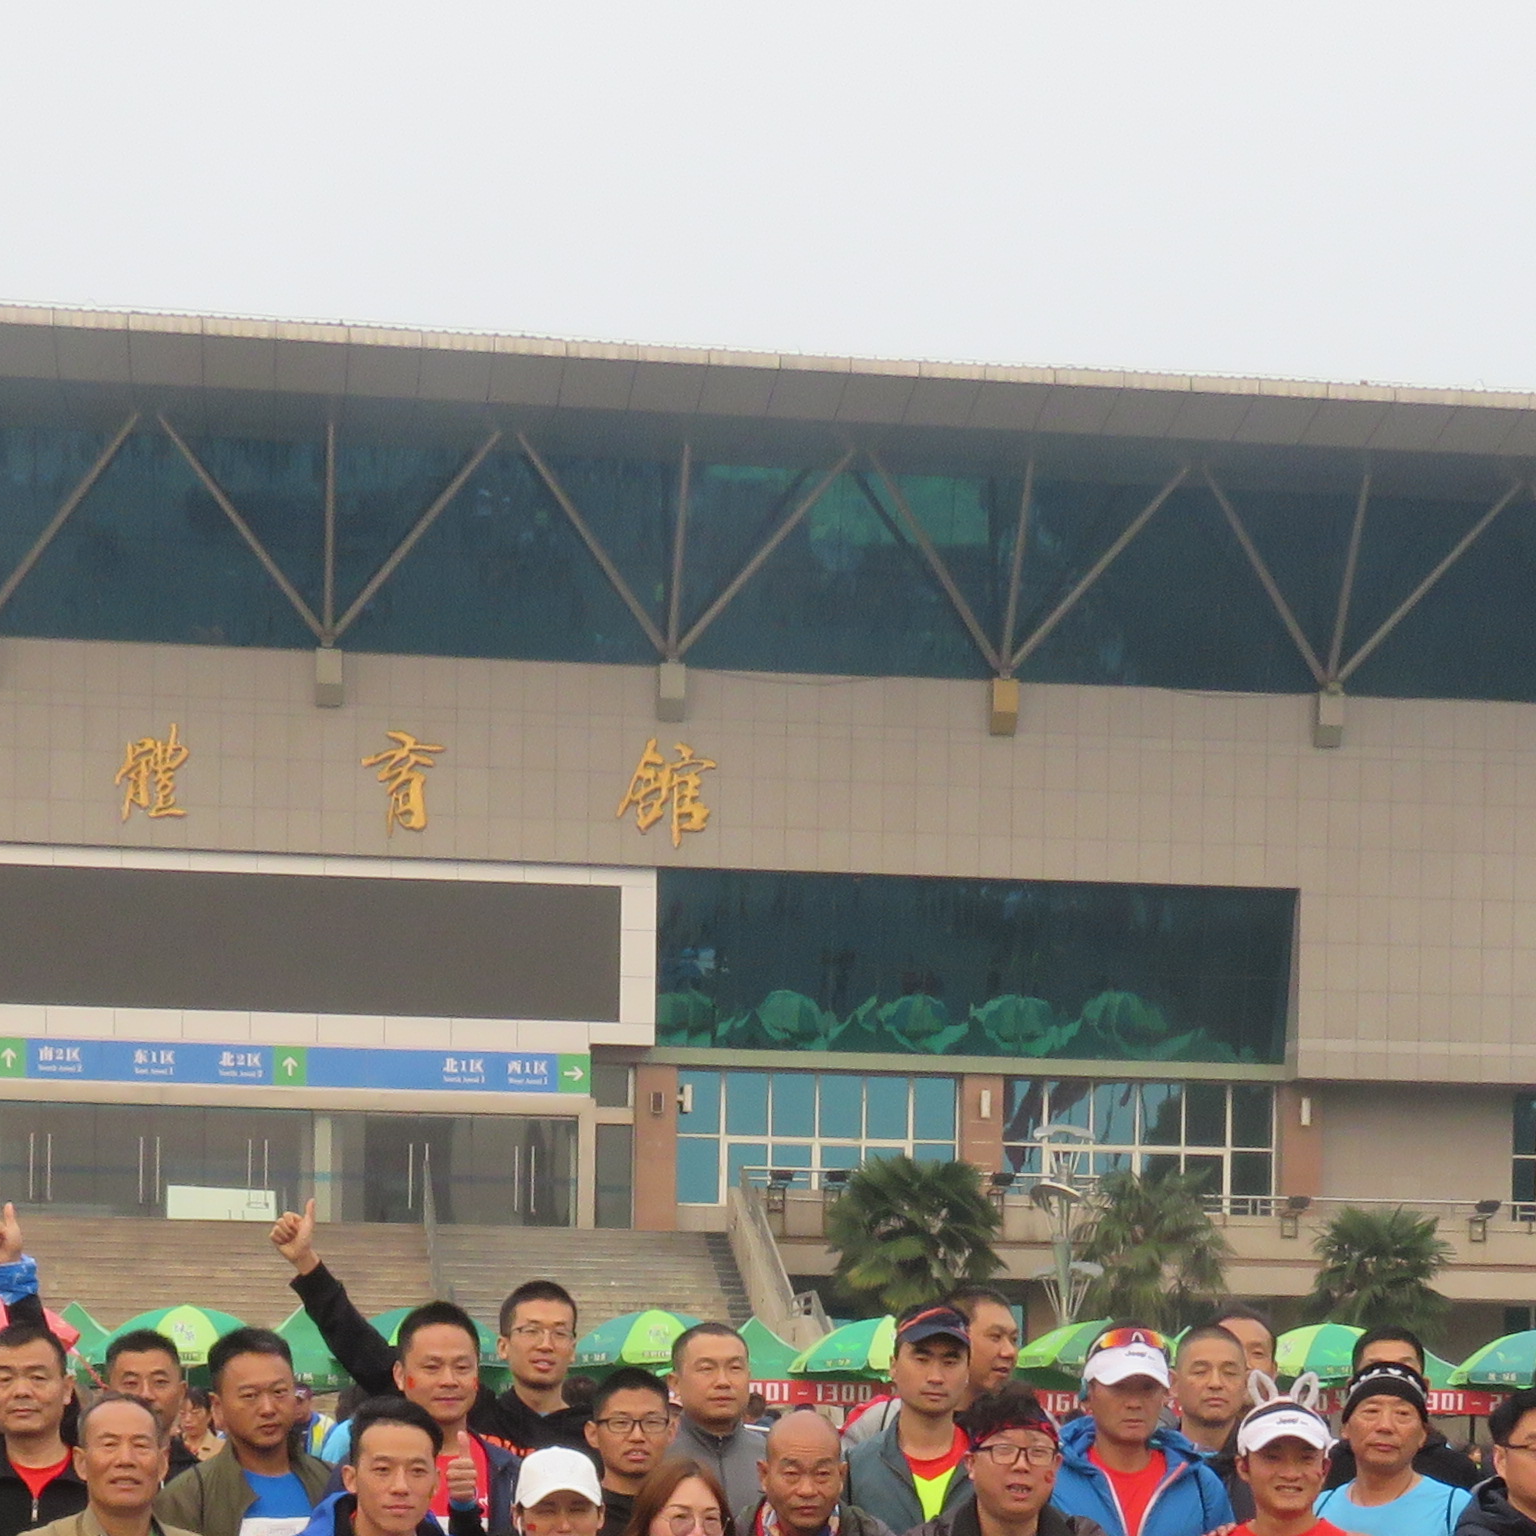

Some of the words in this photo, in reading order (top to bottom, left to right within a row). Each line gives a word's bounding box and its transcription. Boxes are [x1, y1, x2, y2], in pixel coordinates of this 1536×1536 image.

[38, 1046, 81, 1062] 南2区
[133, 1048, 175, 1065] 东1区
[219, 1051, 262, 1068] 北2区
[443, 1057, 484, 1074] 北1区
[816, 1383, 872, 1402] 1300
